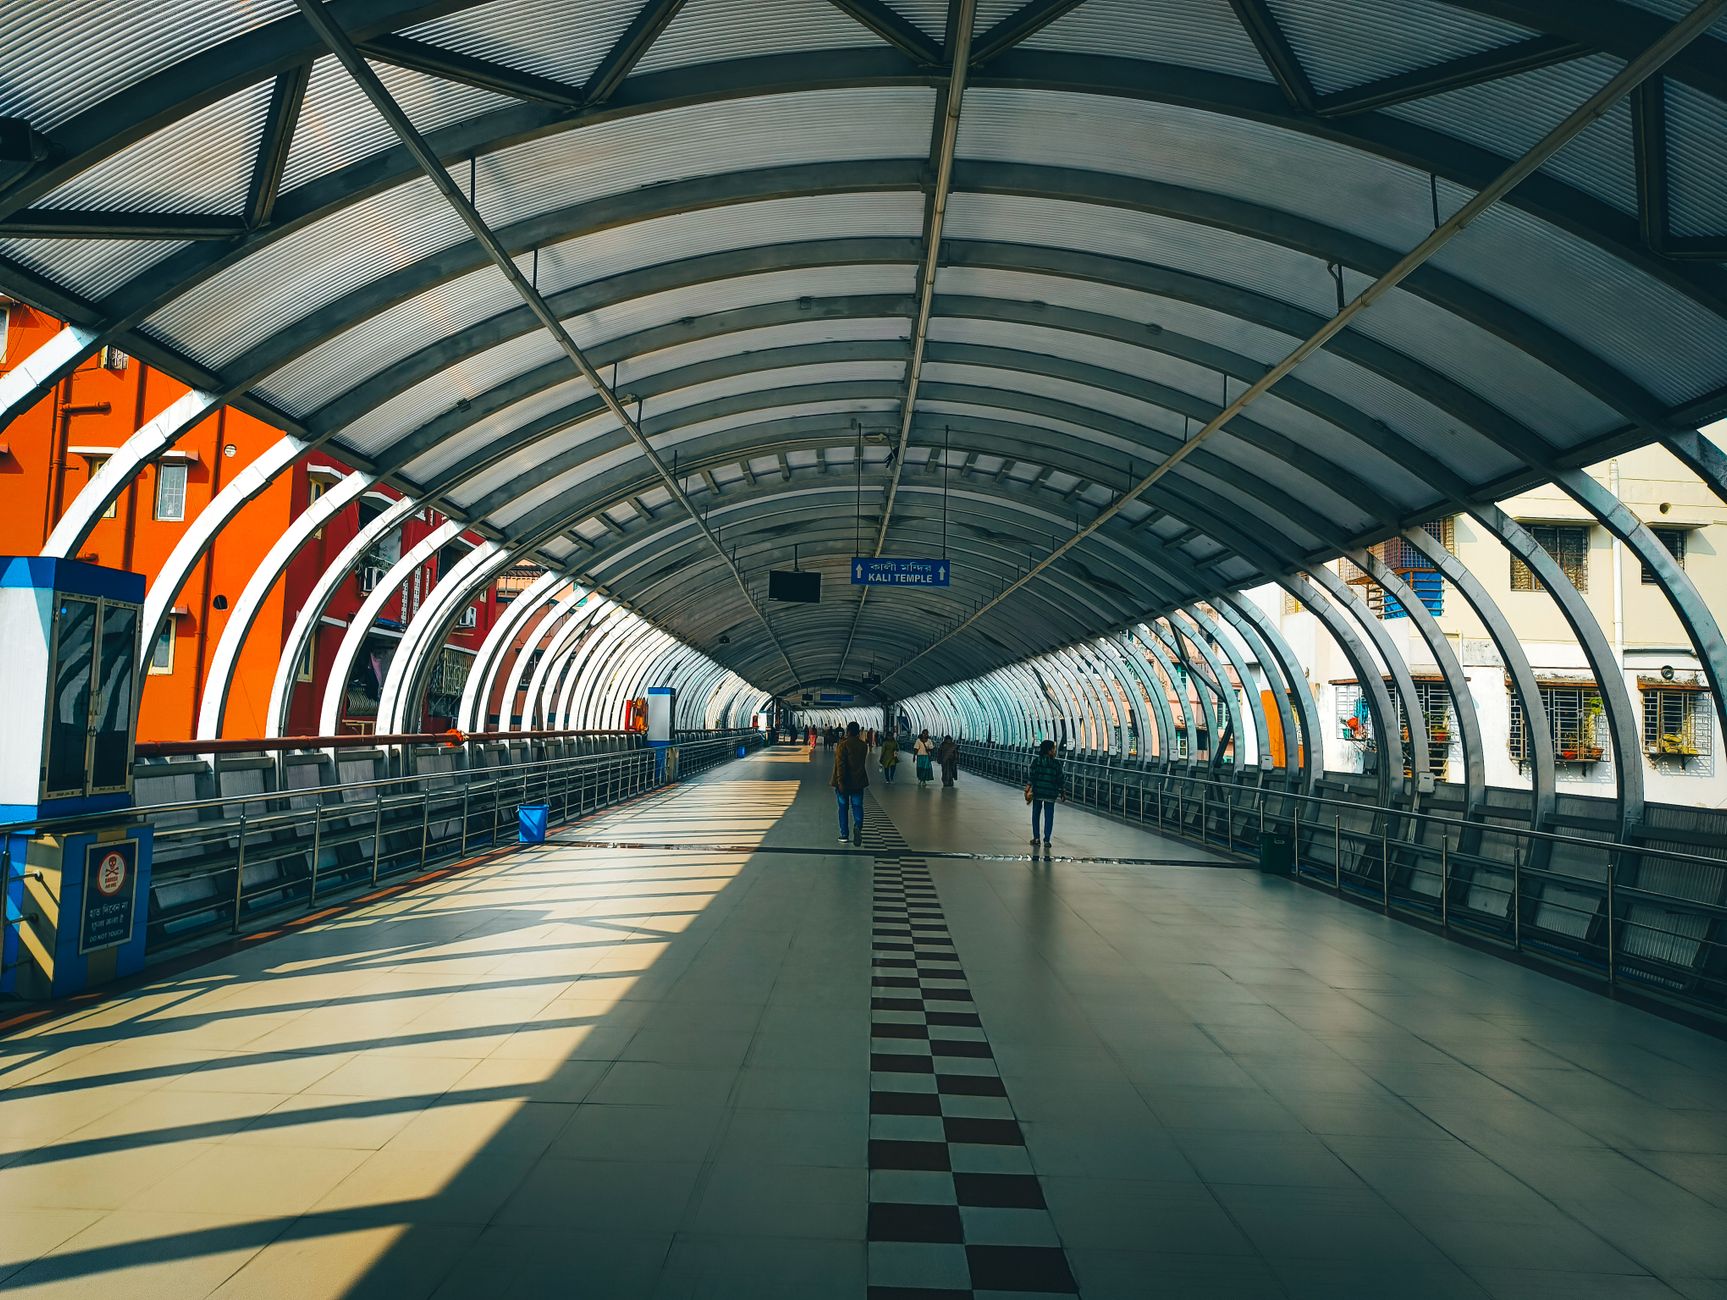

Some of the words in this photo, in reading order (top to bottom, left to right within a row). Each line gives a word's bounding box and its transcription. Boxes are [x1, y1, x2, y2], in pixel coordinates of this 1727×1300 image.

[869, 561, 896, 571] কালী
[900, 561, 932, 572] মন্দির
[868, 573, 890, 582] KALI
[894, 573, 933, 583] TEMPLE
